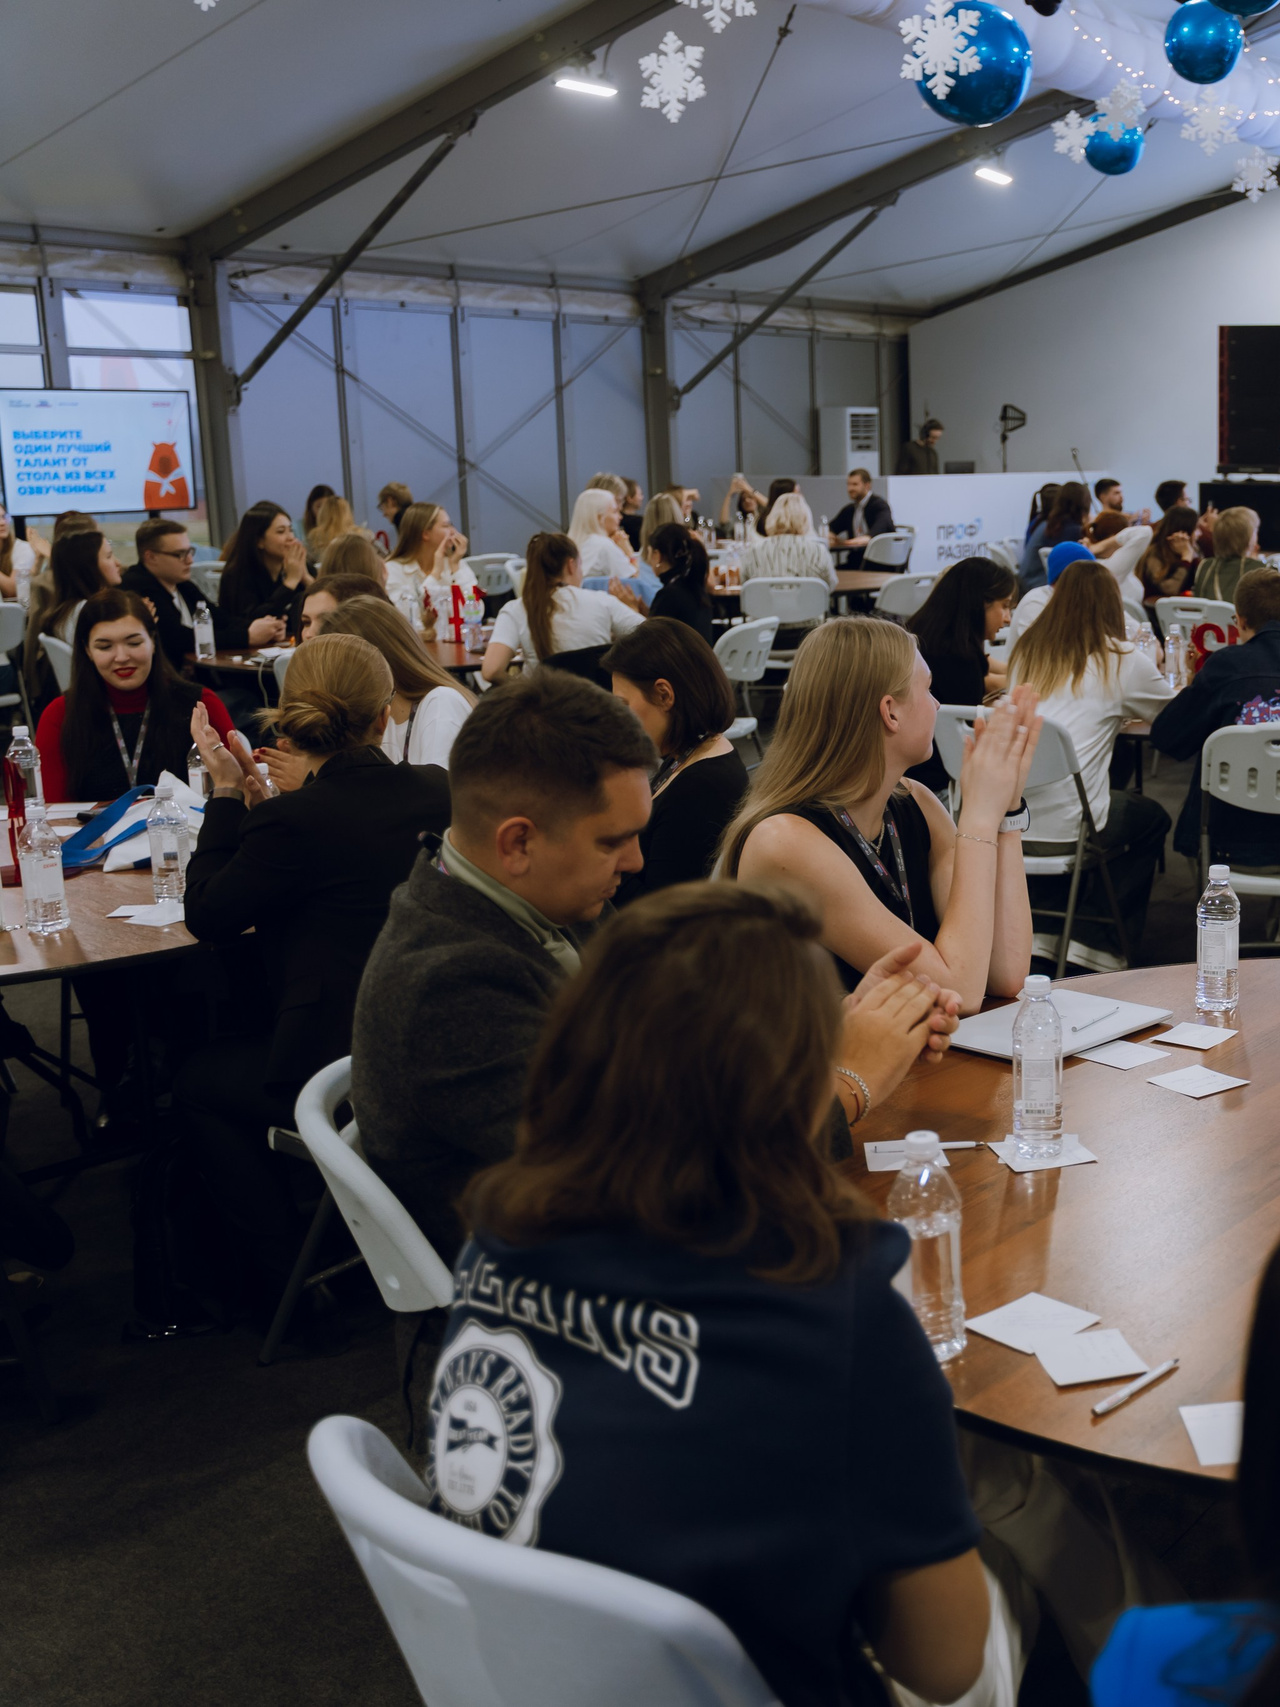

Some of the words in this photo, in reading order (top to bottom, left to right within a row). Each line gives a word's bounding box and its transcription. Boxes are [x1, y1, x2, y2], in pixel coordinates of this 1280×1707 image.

[13, 430, 82, 439] ВЫБЕРИТЕ
[14, 444, 52, 454] ОДИН
[56, 441, 112, 453] ЛУЧШИЙ
[15, 458, 67, 467] ТАЛАНТ
[72, 457, 88, 466] ОТ
[16, 471, 60, 481] СТОЛА
[65, 470, 80, 480] ИЗ
[85, 470, 115, 480] ВСЕХ
[17, 484, 106, 495] ОЗВУЧЕННЫХ
[937, 523, 978, 540] ПРОФ
[489, 1365, 534, 1478] READY
